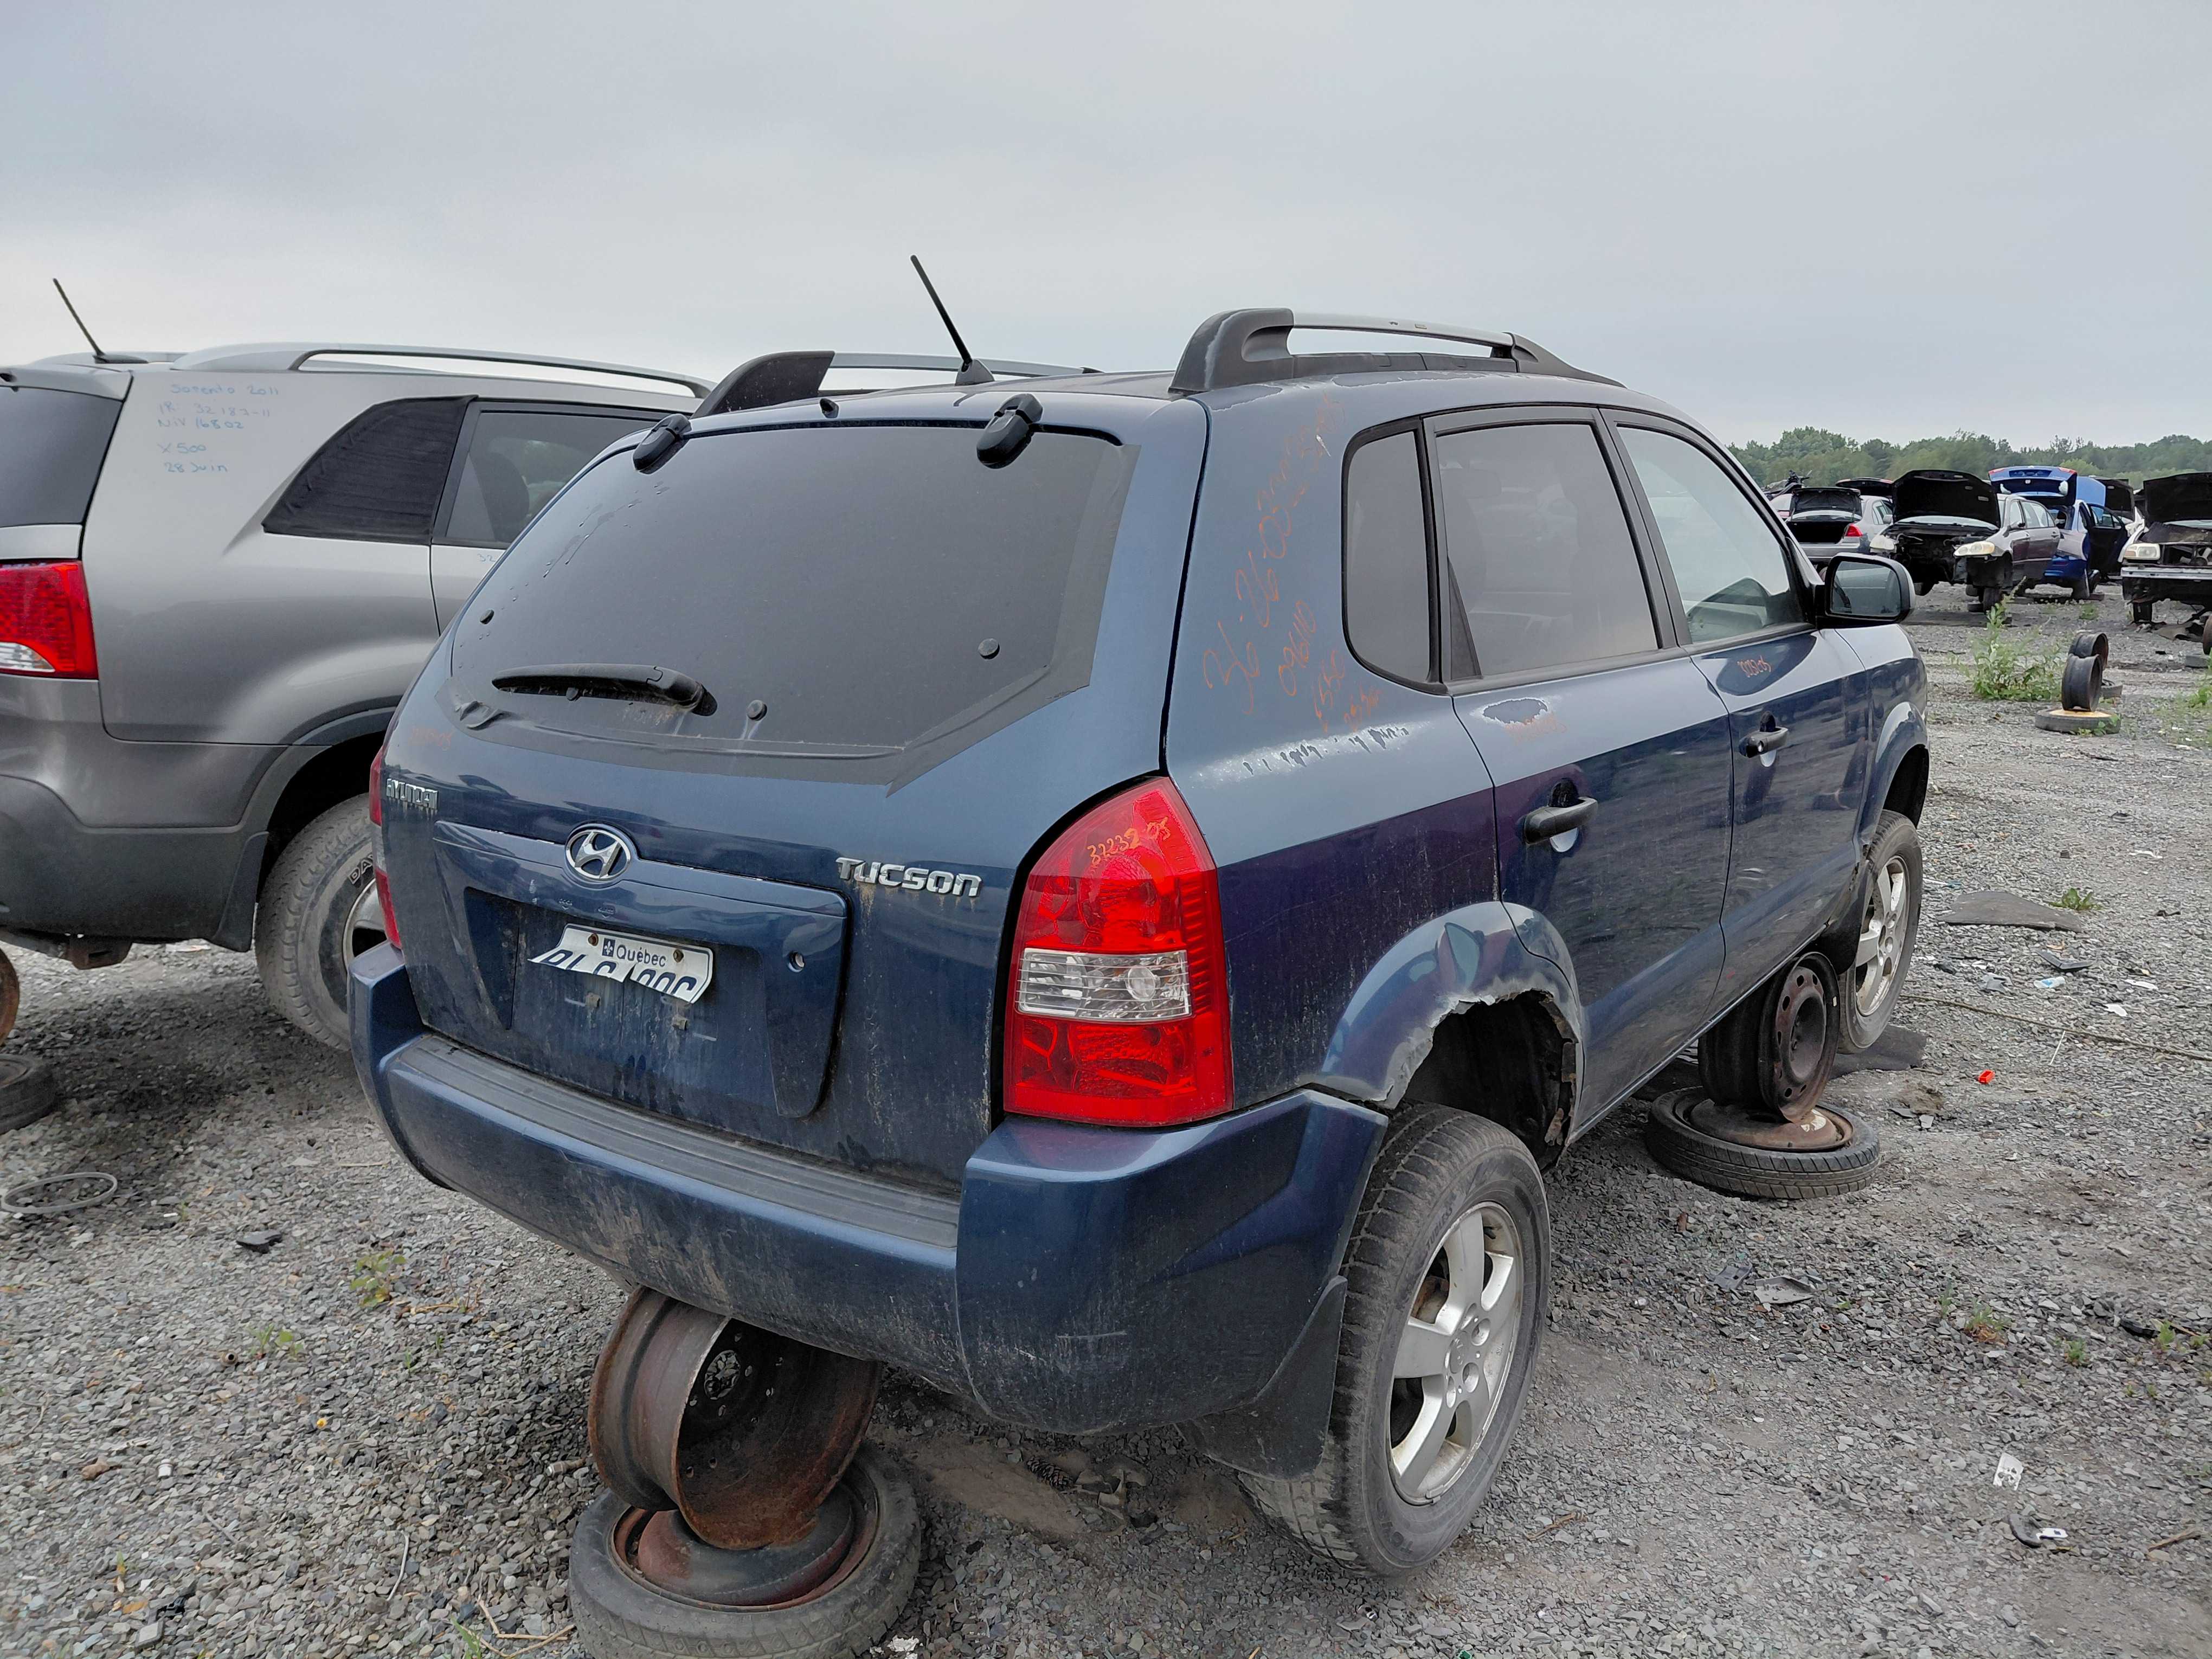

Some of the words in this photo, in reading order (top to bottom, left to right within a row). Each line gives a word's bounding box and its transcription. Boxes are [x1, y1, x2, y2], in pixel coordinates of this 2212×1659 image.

[247, 384, 279, 395] 2011
[177, 442, 207, 454] 500
[164, 461, 184, 473] 28
[835, 857, 982, 897] TUCSON
[616, 944, 667, 968] Québec
